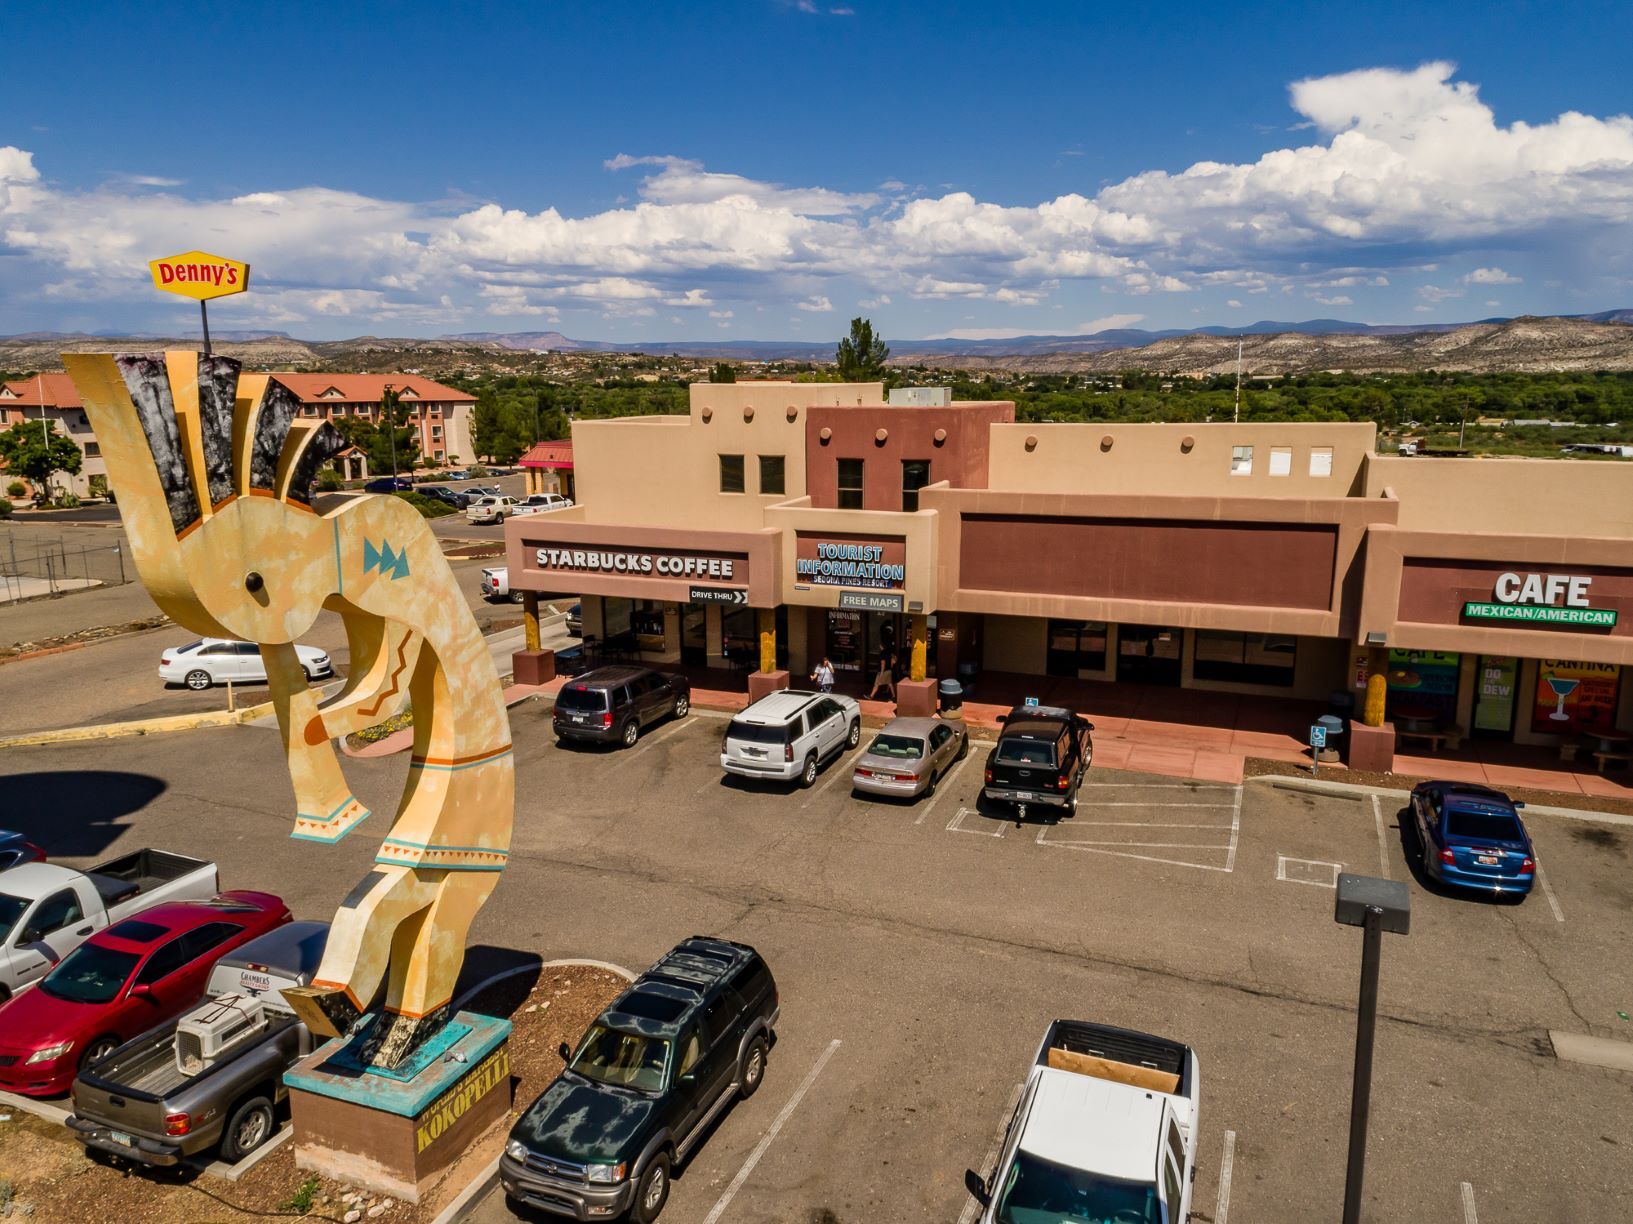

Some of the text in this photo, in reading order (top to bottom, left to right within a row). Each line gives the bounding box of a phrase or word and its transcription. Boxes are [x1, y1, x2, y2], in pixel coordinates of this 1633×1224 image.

[158, 262, 238, 286] Denny's
[817, 543, 883, 562] TOURIST
[536, 549, 734, 577] STARBUCKS COFFEE
[797, 559, 904, 580] INFORMATION
[813, 575, 889, 588] SEDONA PINES RESORT
[1495, 572, 1592, 607] CAFE
[691, 591, 733, 601] DRIVE THRU
[843, 595, 899, 608] FREE MAPS
[1468, 605, 1614, 624] MEXICAN/AMERICAN
[1484, 668, 1502, 679] DO
[1483, 684, 1511, 696] DEW
[417, 1051, 511, 1154] KOKOPELLI
[421, 1083, 463, 1122] WORLDS
